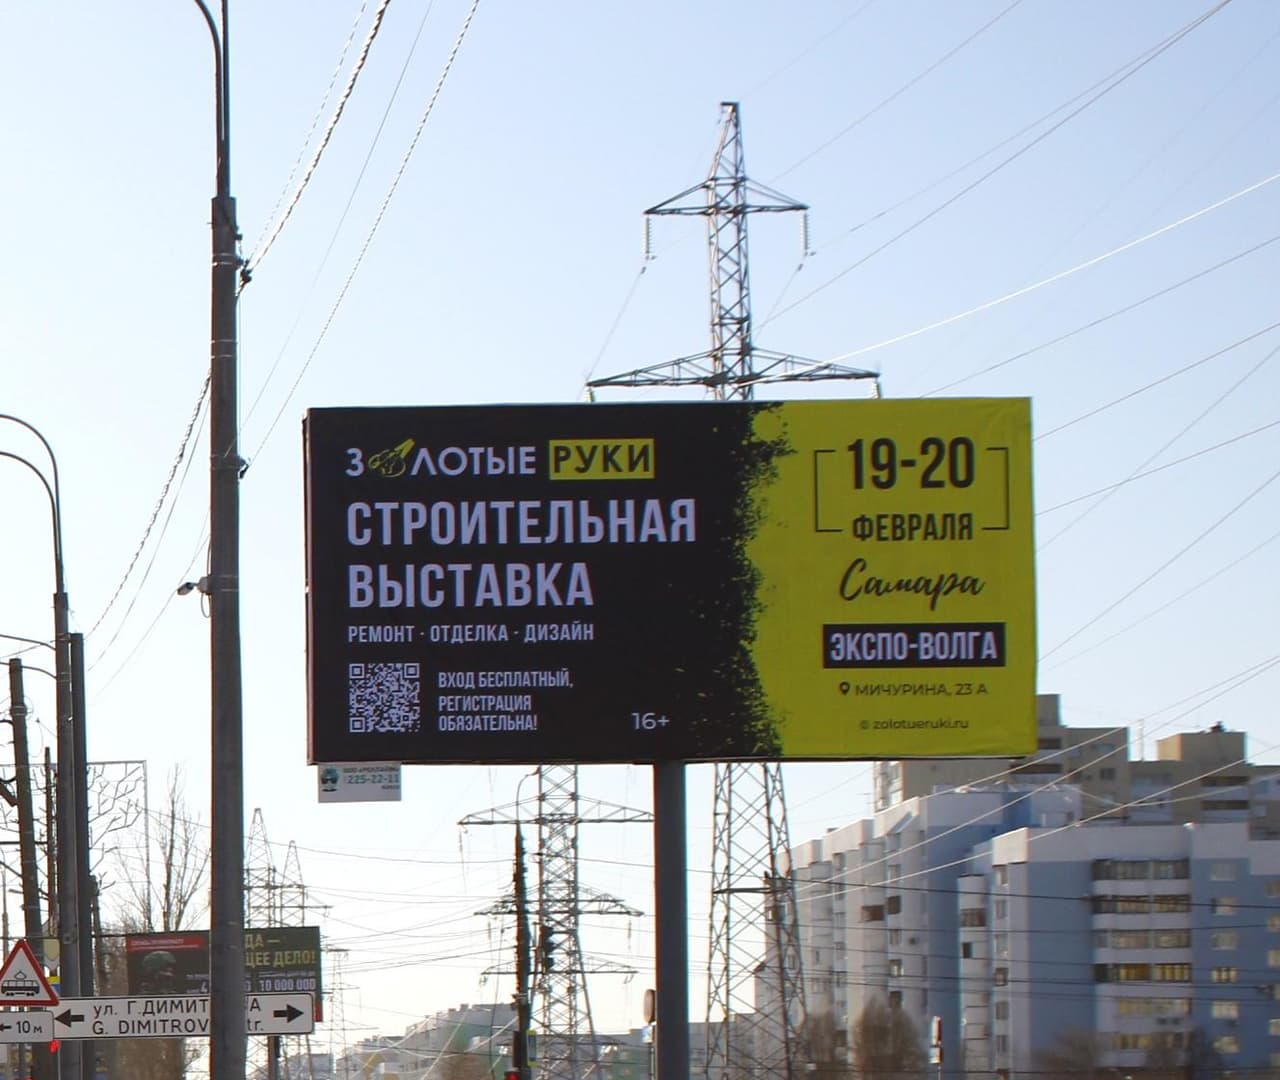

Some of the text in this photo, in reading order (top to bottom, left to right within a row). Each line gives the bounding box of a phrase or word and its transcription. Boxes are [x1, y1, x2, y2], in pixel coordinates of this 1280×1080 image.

[553, 444, 652, 474] РУКИ
[847, 437, 976, 490] 19-20
[346, 498, 696, 546] СТРОИТЕЛЬНАЯ
[852, 512, 974, 542] ФЕВРАЛЯ
[348, 562, 595, 608] ВЫСТАВКА
[840, 558, 987, 612] Самара
[348, 620, 595, 644] РЕМОНТ ОТДЕЛКА ДИЗАЙН
[829, 631, 999, 662] ЭКСПО-ВОЛГА
[437, 667, 575, 690] ВХОД БЕСПЛАТНЫЙ,
[855, 682, 989, 697] МИЧУРИНА, 23 А
[438, 695, 532, 713] РЕГИСТРАЦИЯ
[438, 714, 539, 732] ОБЯЗАТЕЛЬНА!
[631, 712, 671, 731] 16+
[272, 949, 316, 968] ДЕЛО!
[93, 1003, 119, 1019] ул.
[16, 1020, 43, 1035] 10 м
[92, 1022, 110, 1036] G.
[118, 1018, 209, 1035] DIMITROV
